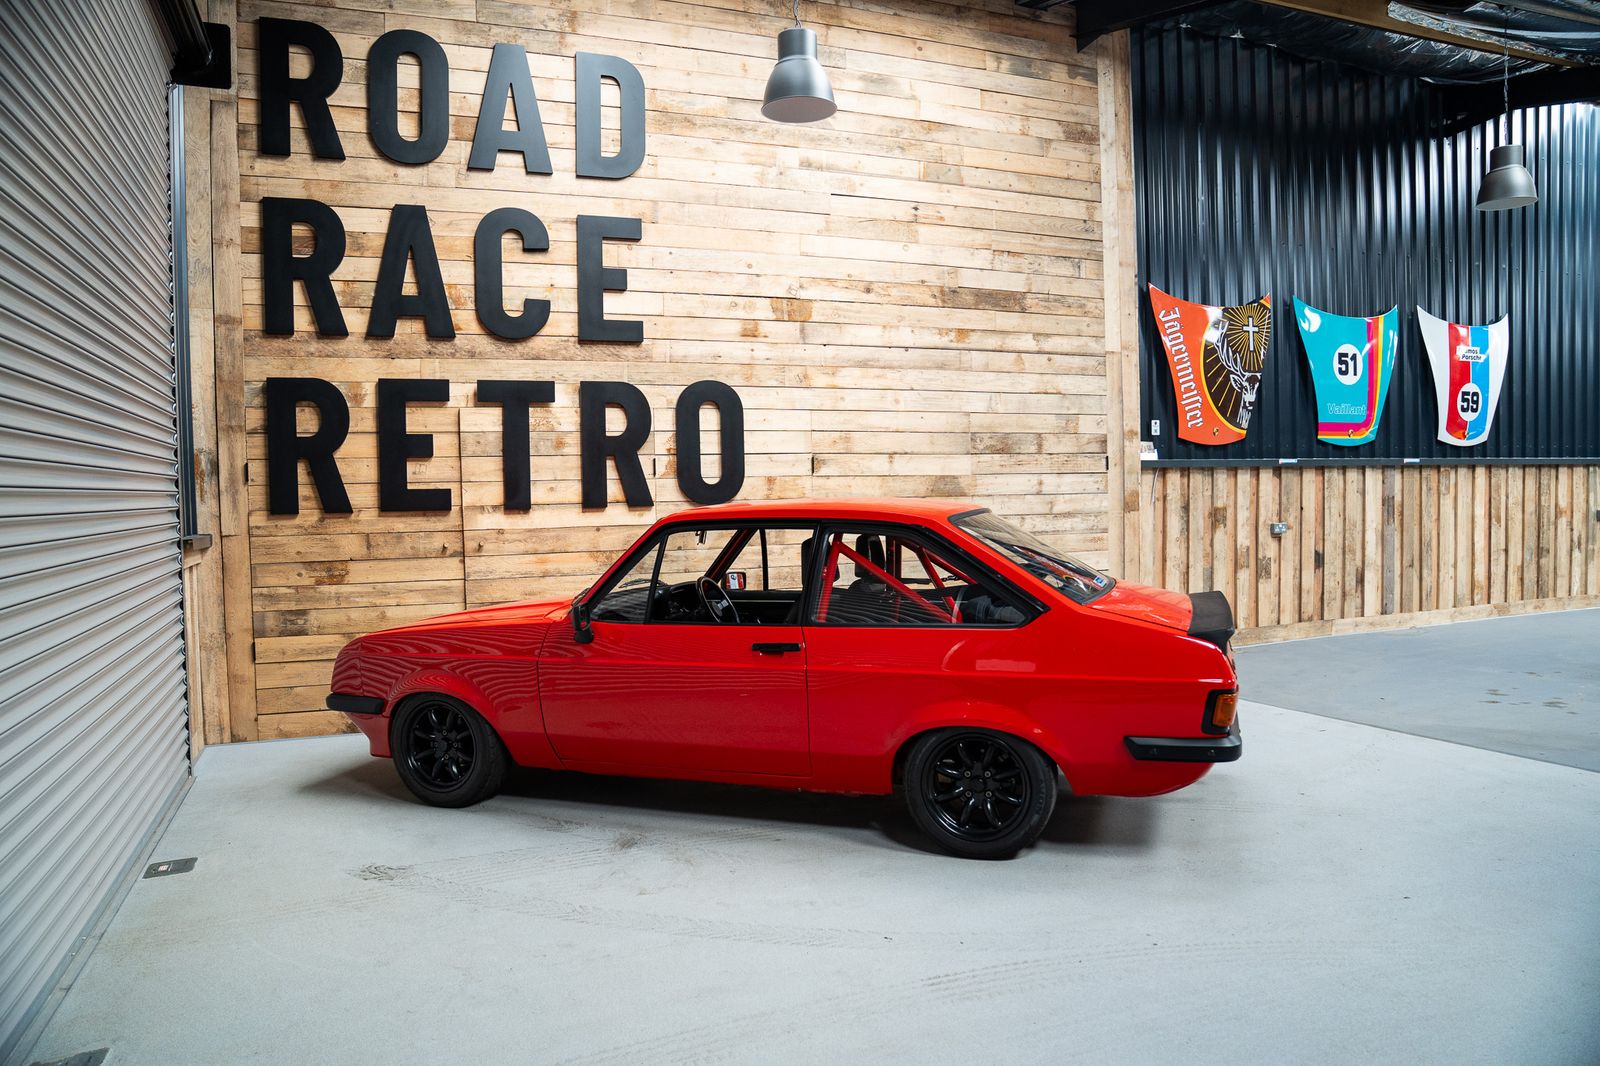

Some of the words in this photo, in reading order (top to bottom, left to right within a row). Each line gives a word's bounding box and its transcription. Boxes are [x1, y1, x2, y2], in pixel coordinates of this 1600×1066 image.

[259, 16, 645, 179] ROAD
[262, 197, 644, 343] RACE
[1338, 352, 1357, 376] 51
[1460, 391, 1480, 413] 59
[266, 377, 745, 515] RETRO
[1327, 403, 1366, 415] Vaillant
